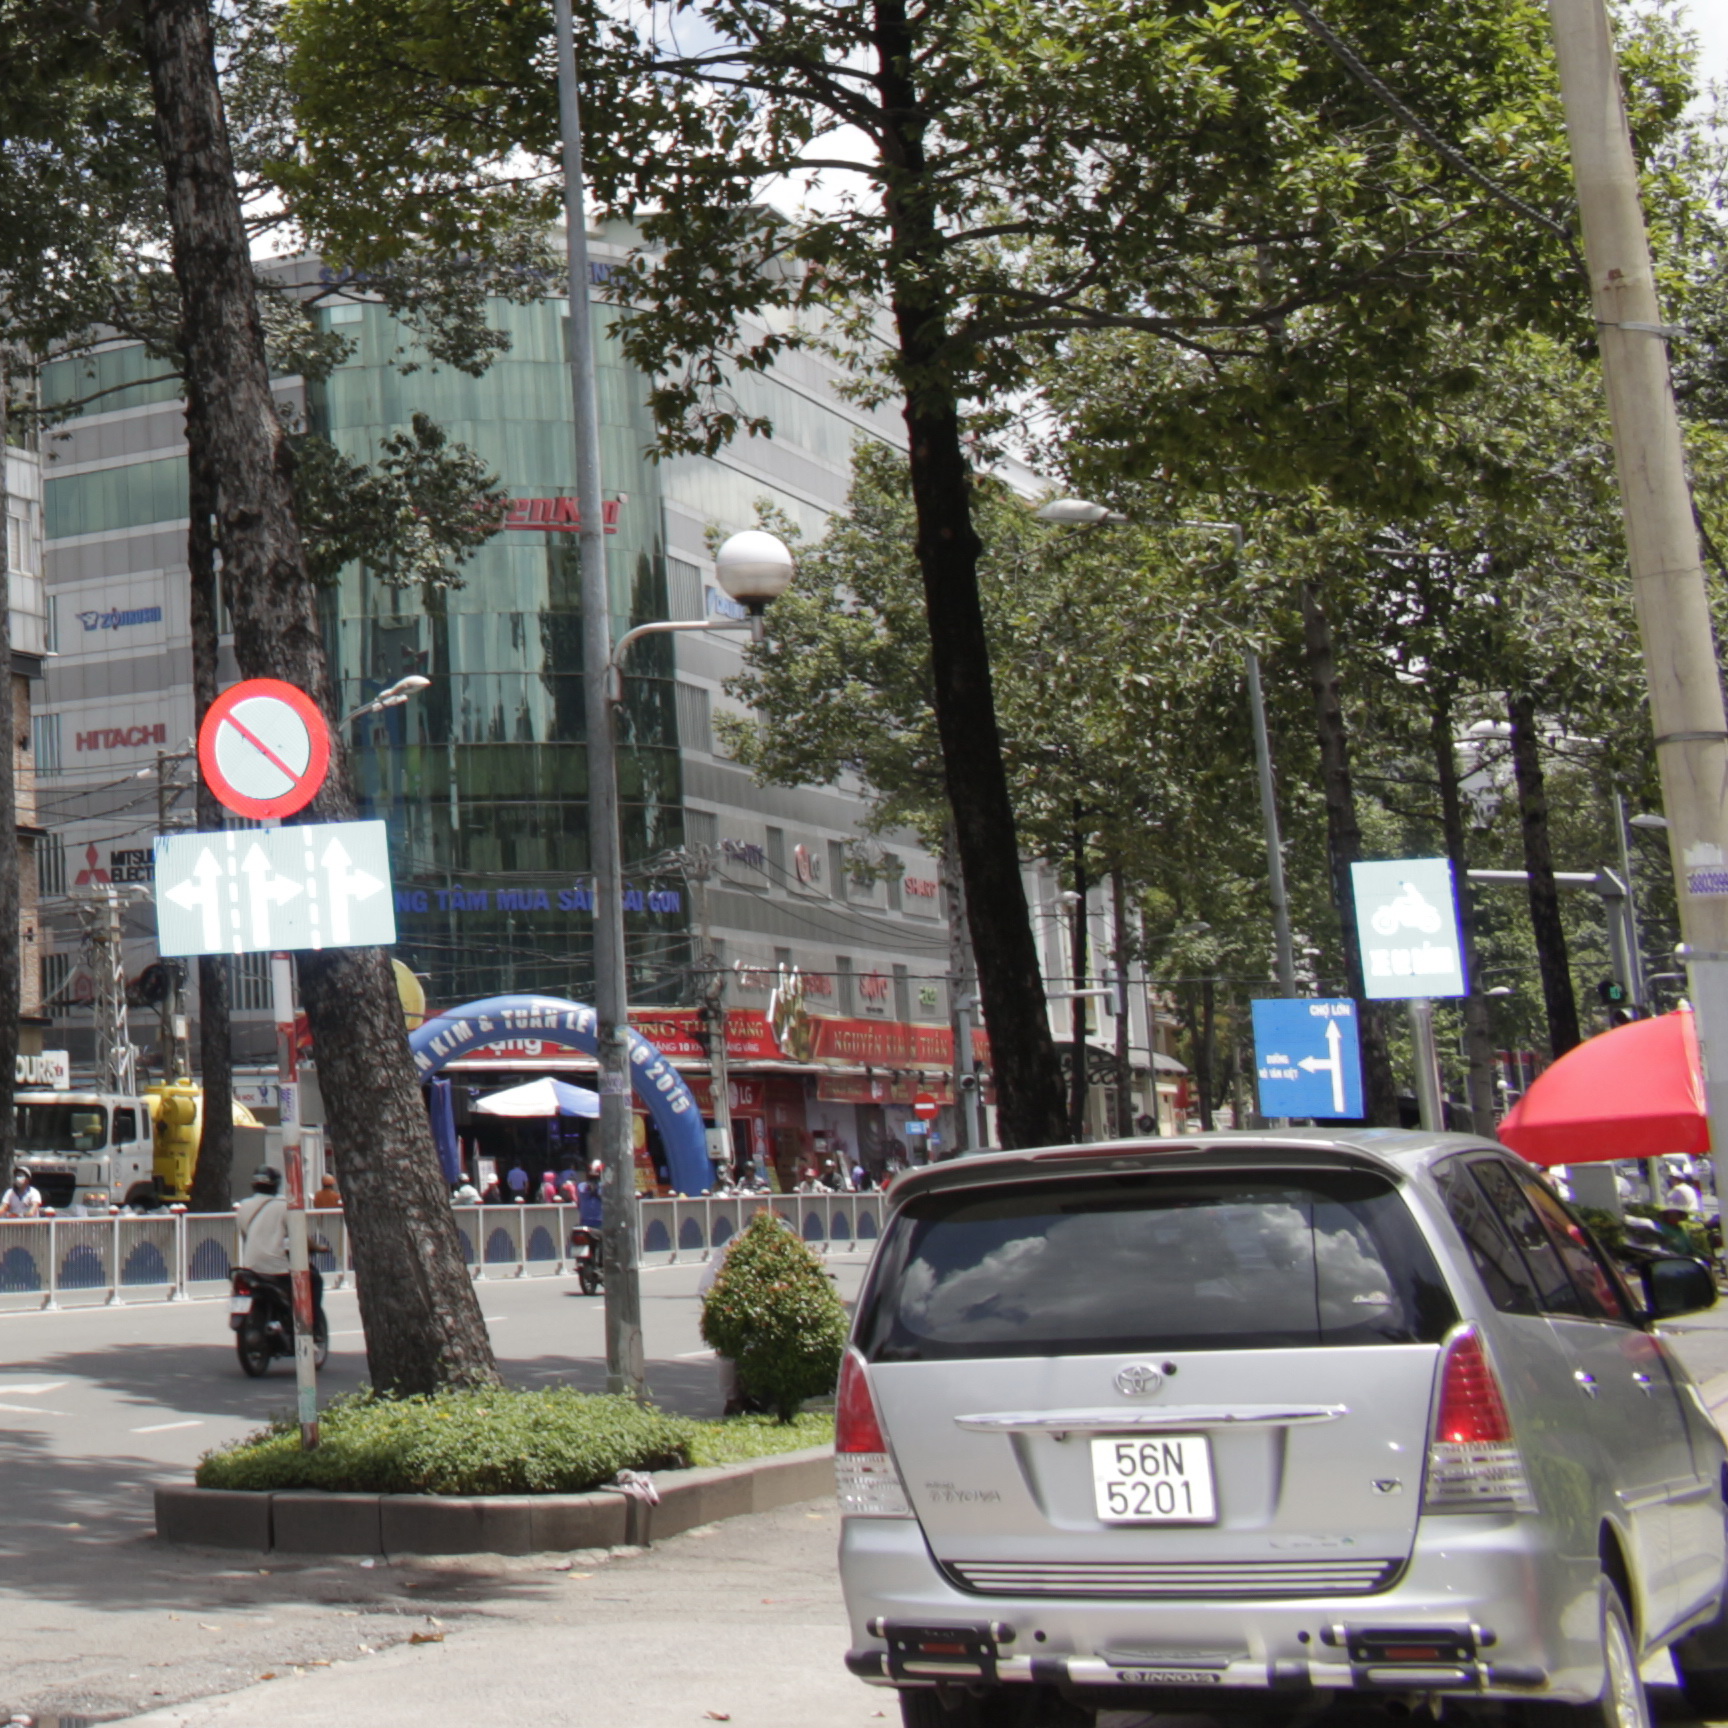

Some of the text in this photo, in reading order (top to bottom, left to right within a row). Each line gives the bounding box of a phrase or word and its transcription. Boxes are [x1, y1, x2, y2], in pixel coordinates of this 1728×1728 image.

[76, 723, 165, 752] HITACHI
[435, 884, 489, 912] TÂM
[497, 889, 550, 911] MUA
[1309, 1004, 1330, 1018] CHỢ
[679, 1042, 689, 1051] 10
[429, 1020, 474, 1057] KIM
[477, 1014, 494, 1032] &
[645, 1062, 691, 1114] 2015
[740, 1086, 753, 1104] LG
[1115, 1442, 1184, 1477] 56N
[1107, 1480, 1193, 1515] 5201
[1144, 1672, 1214, 1683] INNOVA
